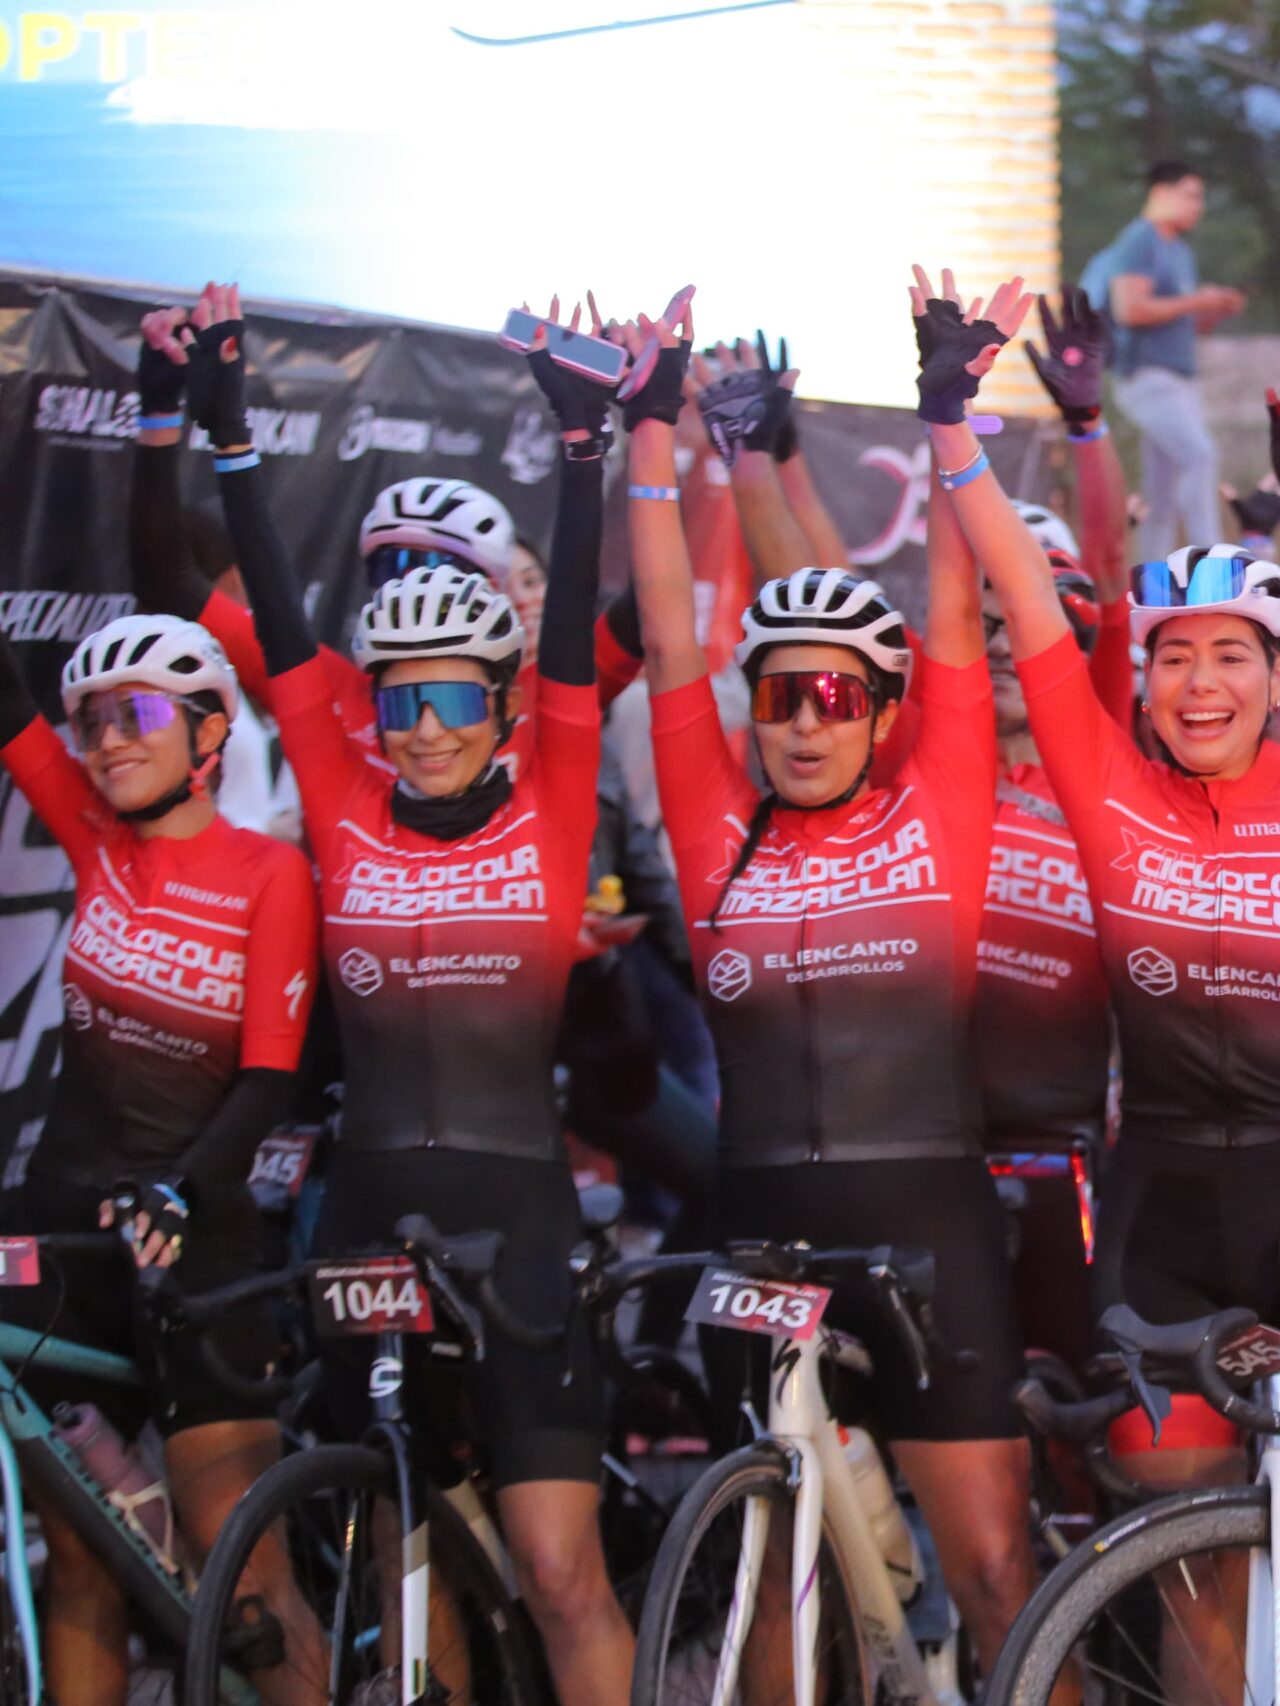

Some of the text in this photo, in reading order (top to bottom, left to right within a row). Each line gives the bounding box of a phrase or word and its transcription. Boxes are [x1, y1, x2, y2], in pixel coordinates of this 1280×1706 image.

[350, 844, 539, 890] CICLOTOUR
[719, 855, 937, 915] MAZATLAN
[341, 880, 544, 916] MAZATLAN
[85, 896, 246, 980] CICLOTOUR
[763, 939, 918, 969] EL ENCANTO
[71, 920, 244, 1010] MAZATLAN
[389, 955, 521, 973] EL ENCANTO
[785, 961, 906, 984] DESARROLLOS
[1187, 964, 1212, 980] EL
[323, 1278, 422, 1321] 1044
[710, 1284, 812, 1328] 1043
